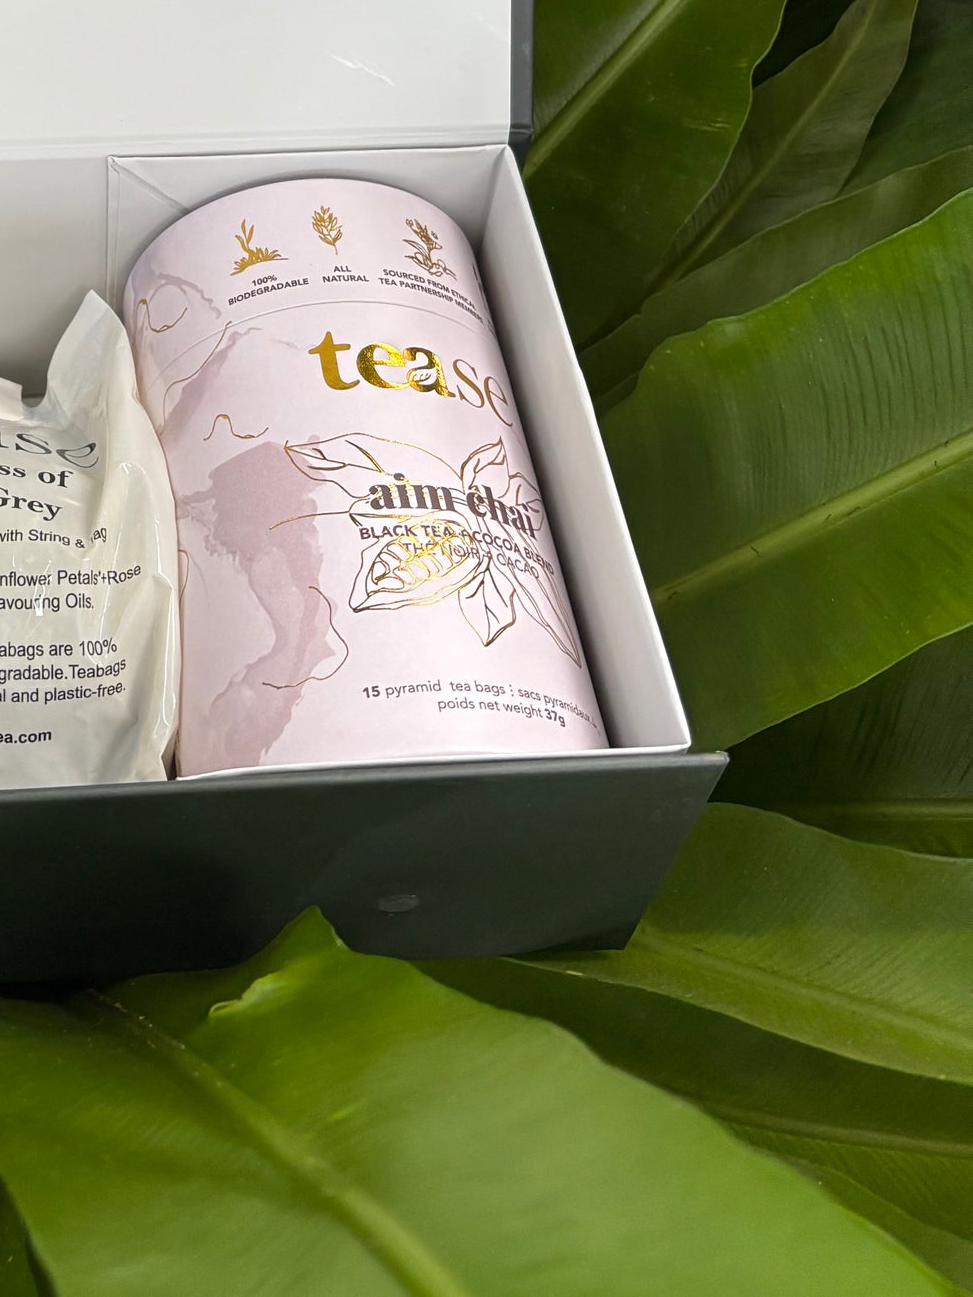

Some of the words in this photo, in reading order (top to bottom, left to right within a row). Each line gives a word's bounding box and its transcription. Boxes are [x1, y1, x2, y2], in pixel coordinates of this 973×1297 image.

[251, 274, 277, 286] 100%
[323, 274, 369, 282] NATURAL
[383, 268, 425, 284] SOURCED
[427, 279, 450, 293] FROM
[228, 278, 309, 306] BIODEGRADABLE
[379, 278, 397, 286] TEA
[399, 280, 453, 302] PARTNERSHIP
[308, 330, 514, 428] tease
[38, 470, 74, 488] of
[368, 472, 455, 512] aim
[465, 484, 539, 542] chai
[28, 530, 71, 546] String
[75, 539, 85, 548] &
[359, 524, 417, 540] BLACK
[421, 524, 453, 538] TEA
[472, 530, 521, 554] COCOA
[497, 552, 539, 579] CACAO
[65, 593, 95, 610] Oils.
[49, 644, 73, 656] are
[79, 638, 117, 656] 100%
[11, 688, 39, 703] and
[44, 682, 126, 704] plastic-free.
[362, 685, 381, 699] 15
[385, 679, 442, 699] pyramid
[449, 680, 471, 692] tea
[475, 680, 506, 696] bags
[517, 688, 541, 701] sacs
[437, 698, 475, 712] poids
[479, 700, 500, 711] net
[502, 702, 543, 718] weight
[545, 708, 566, 728] 37g
